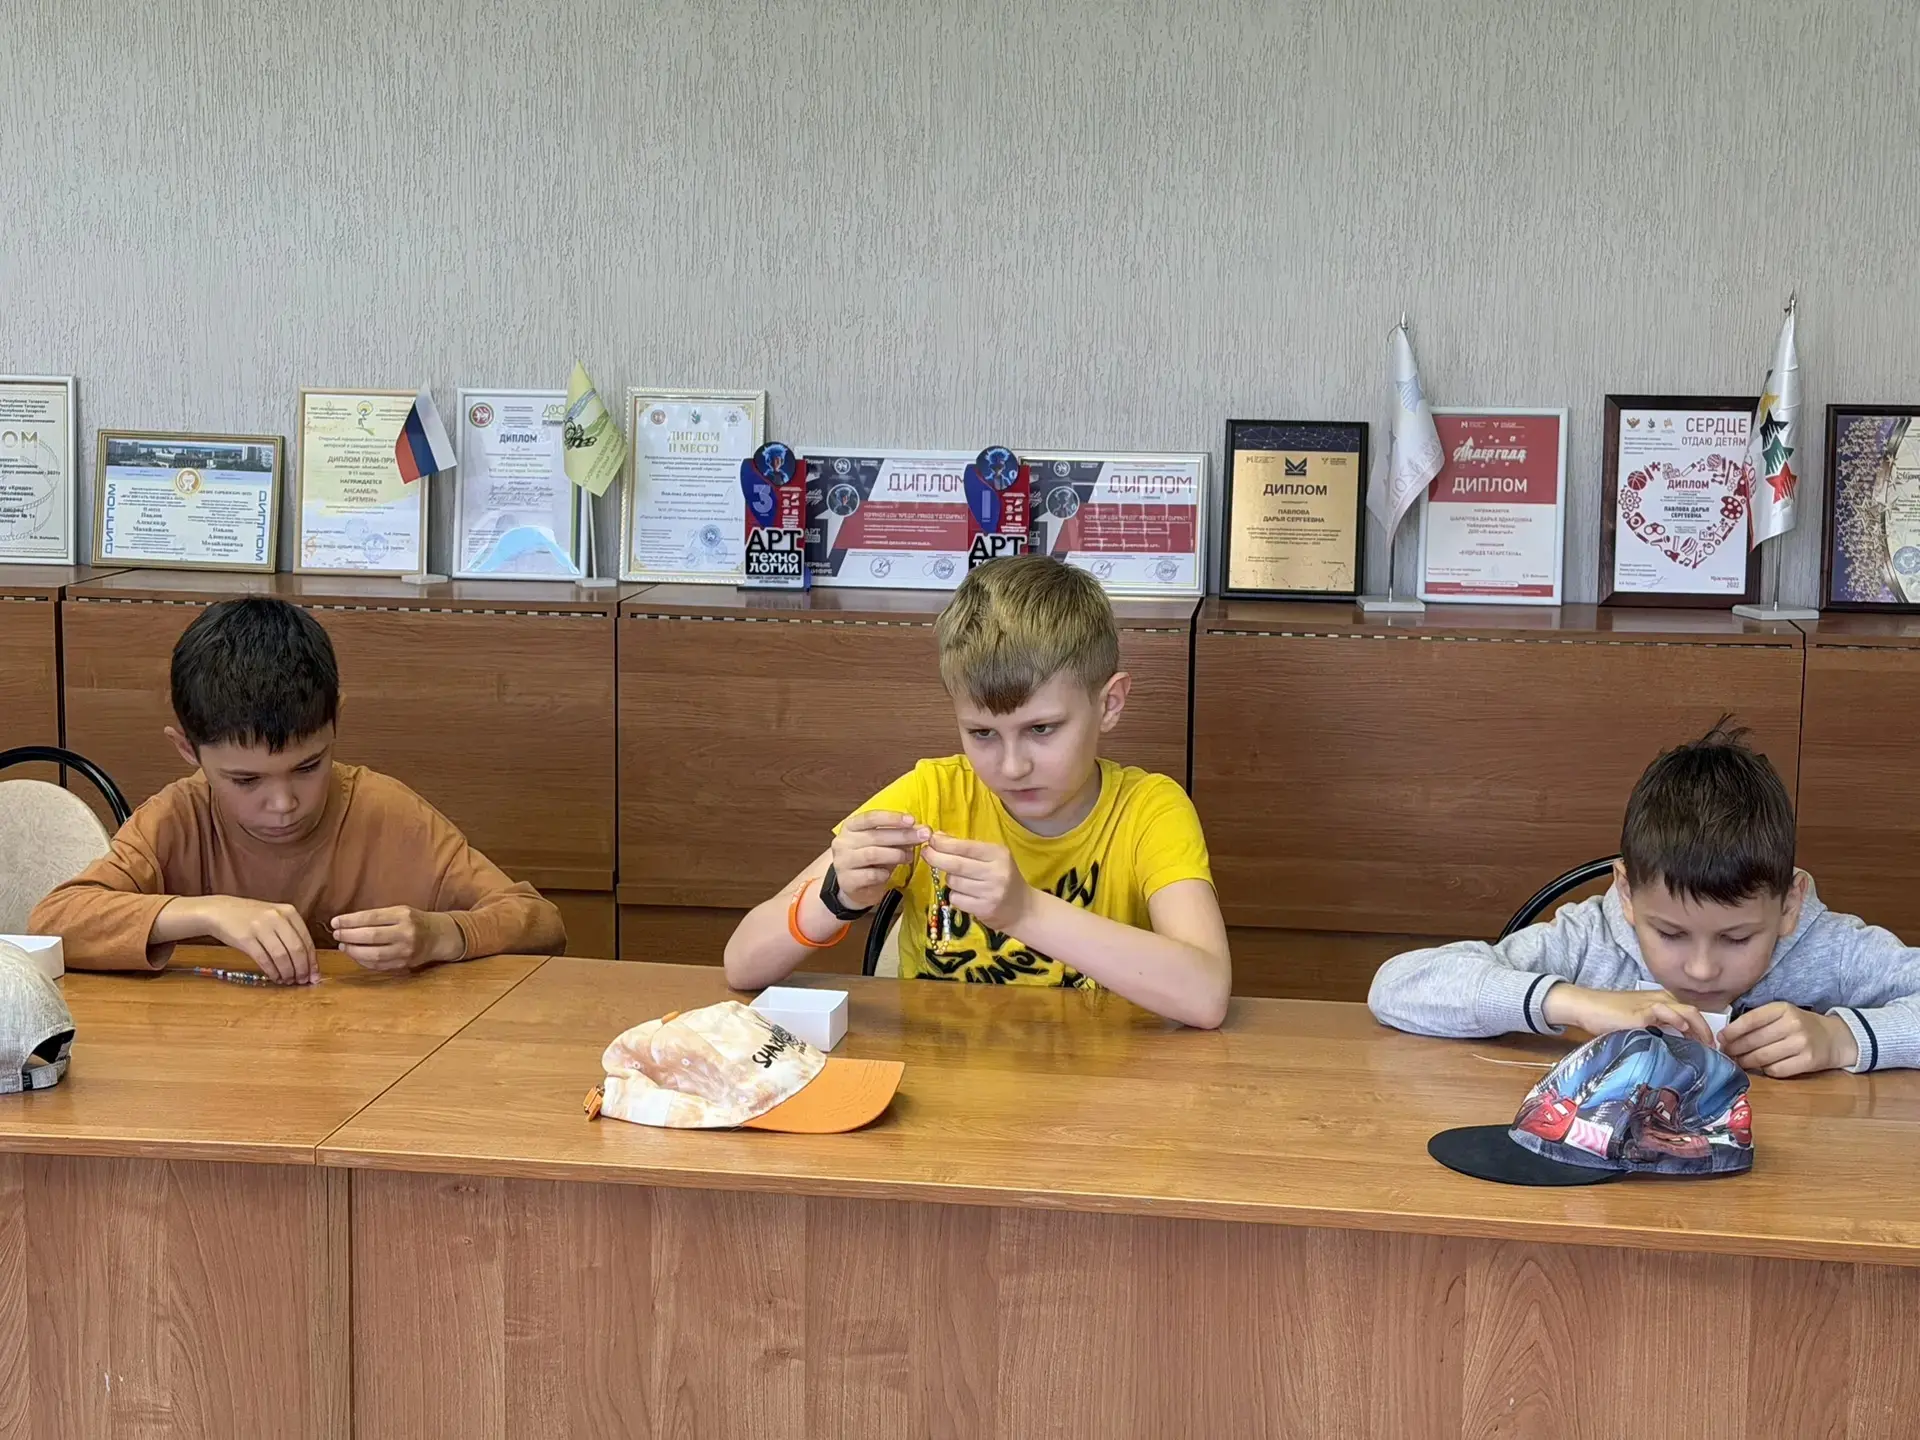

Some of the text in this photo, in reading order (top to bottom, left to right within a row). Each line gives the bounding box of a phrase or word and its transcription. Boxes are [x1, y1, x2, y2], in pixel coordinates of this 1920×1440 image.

[1686, 418, 1747, 435] СЕРДЦЕ
[499, 433, 538, 443] ДИПЛОМ
[667, 431, 721, 442] ДИПЛОМ
[1681, 437, 1712, 447] ОТДАЮ
[1715, 437, 1747, 447] ДЕТЯМ
[679, 443, 720, 453] МЕСТО
[327, 456, 360, 464] ДИПЛОМ
[1107, 475, 1192, 494] ДИПЛОМ
[1263, 484, 1328, 496] ДИПЛОМ
[1452, 477, 1528, 494] ДИПЛОМ
[1667, 479, 1709, 490] ДИПЛОМ
[752, 484, 773, 514] 3
[1278, 508, 1310, 516] ПАВЛОВА
[105, 483, 116, 554] ДИПЛОМ
[255, 490, 268, 561] ДИПЛОМ
[746, 529, 802, 551] АРТ
[969, 535, 1026, 559] АРТ
[749, 551, 799, 562] техно
[749, 563, 800, 575] логии
